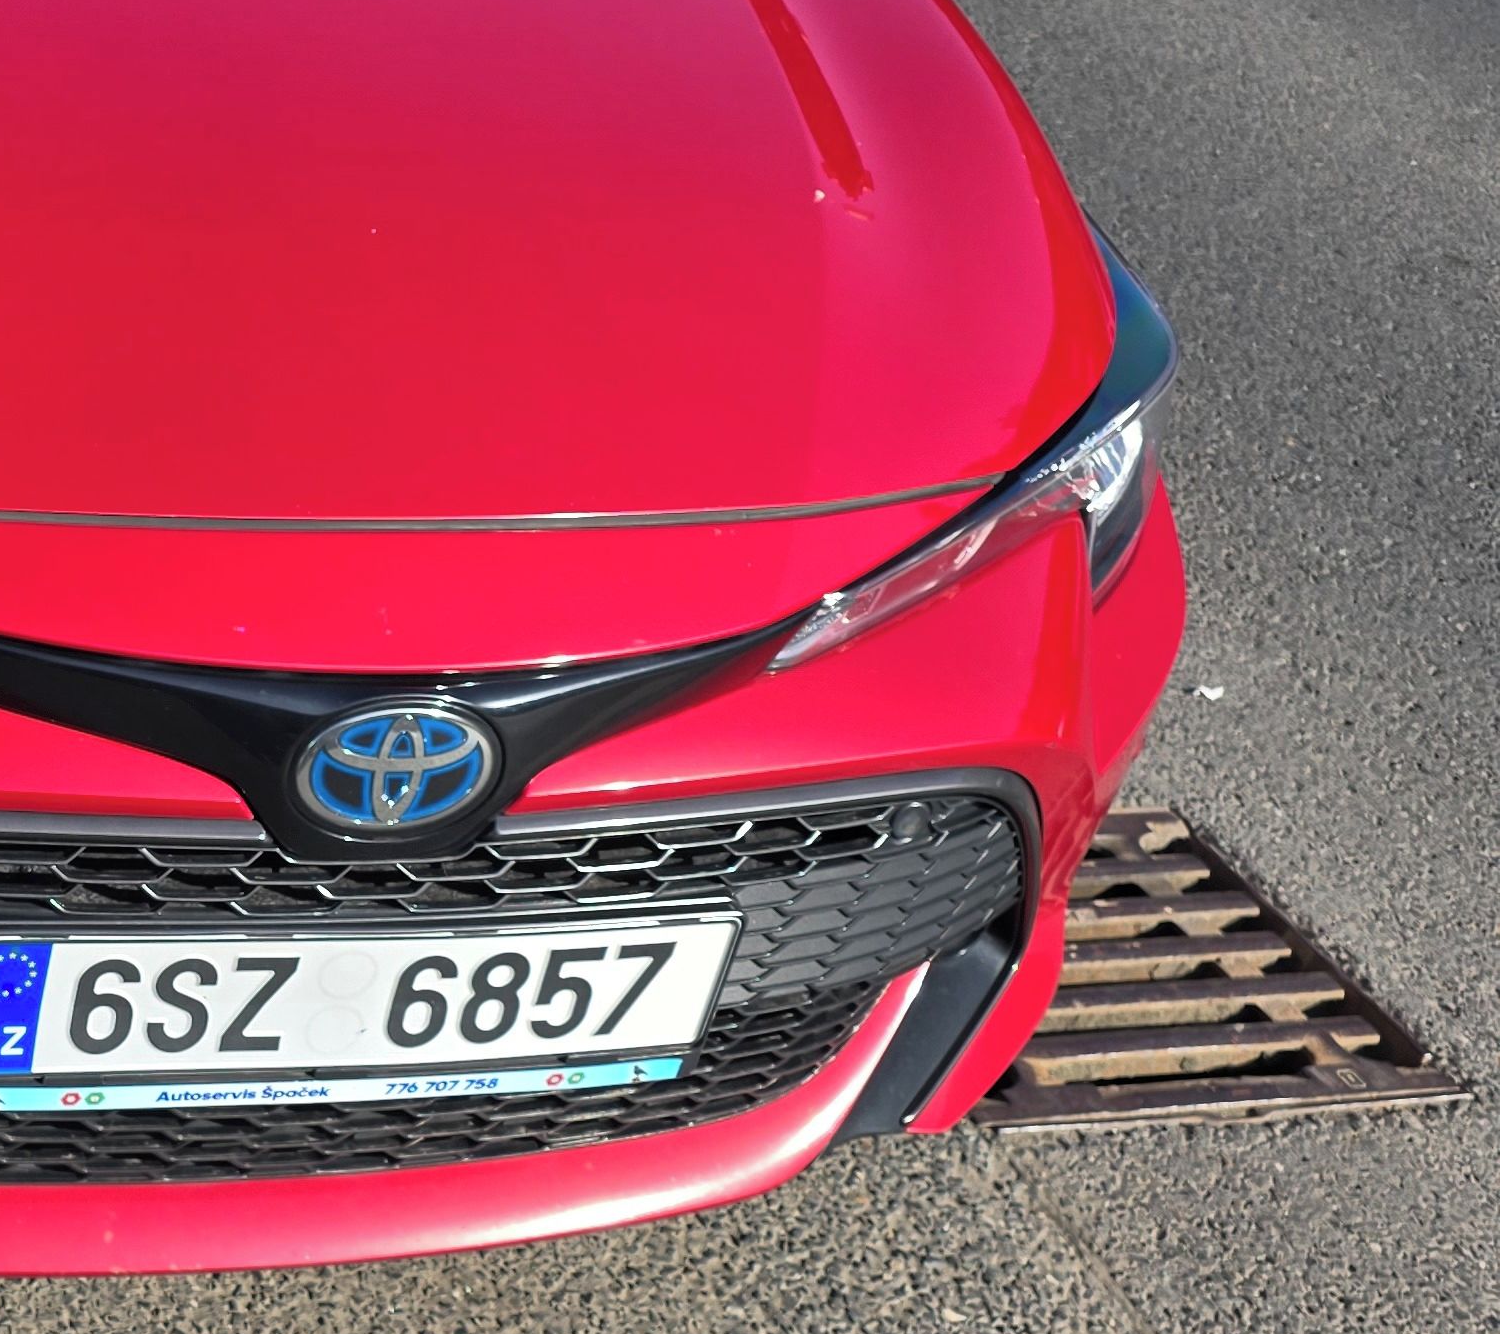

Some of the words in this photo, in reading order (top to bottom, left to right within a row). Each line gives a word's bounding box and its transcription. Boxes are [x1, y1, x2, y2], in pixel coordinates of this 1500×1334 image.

[69, 955, 301, 1055] 6SZ
[385, 941, 678, 1048] 6857
[156, 1089, 256, 1102] Autoservis
[261, 1085, 330, 1100] Špaček
[385, 1083, 418, 1095] 776
[424, 1080, 460, 1092] 707
[464, 1078, 499, 1090] 758
